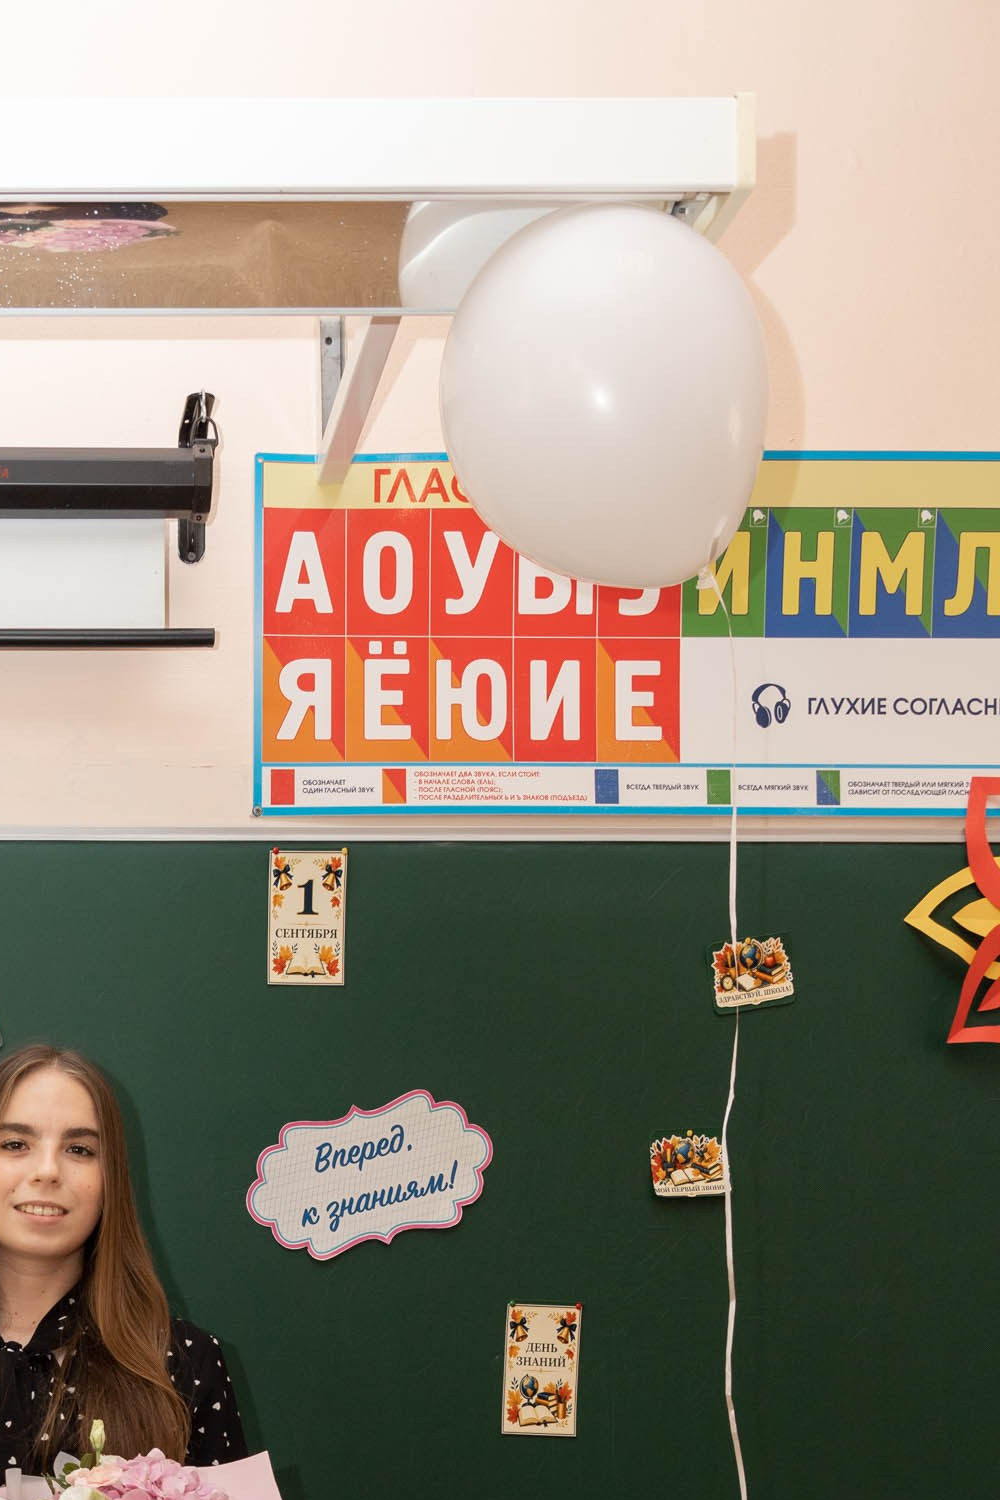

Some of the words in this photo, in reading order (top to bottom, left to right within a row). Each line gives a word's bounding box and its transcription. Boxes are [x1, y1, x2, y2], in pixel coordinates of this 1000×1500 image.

[275, 531, 334, 613] А
[363, 531, 413, 614] О
[443, 531, 500, 615] У
[782, 531, 835, 616] Н
[858, 531, 925, 616] М
[276, 658, 332, 740] Я
[364, 640, 411, 740] Ё
[436, 658, 507, 741] Ю
[530, 660, 580, 741] И
[615, 660, 662, 741] Е
[808, 698, 886, 716] ГЛУХИЕ
[893, 698, 1000, 716] СОГЛАСН
[324, 786, 357, 794] ГЛАСНЫЙ
[653, 783, 682, 791] ТВЕРДЫЙ
[764, 783, 792, 791] МЯГКИЙ
[297, 880, 319, 915] 1
[275, 927, 338, 939] СЕНТЯБРЯ
[301, 1206, 321, 1228] к
[326, 1160, 458, 1232] знаниям!
[526, 1342, 558, 1353] ДЕНЬ
[516, 1356, 566, 1367] ЗНАНИЙ
